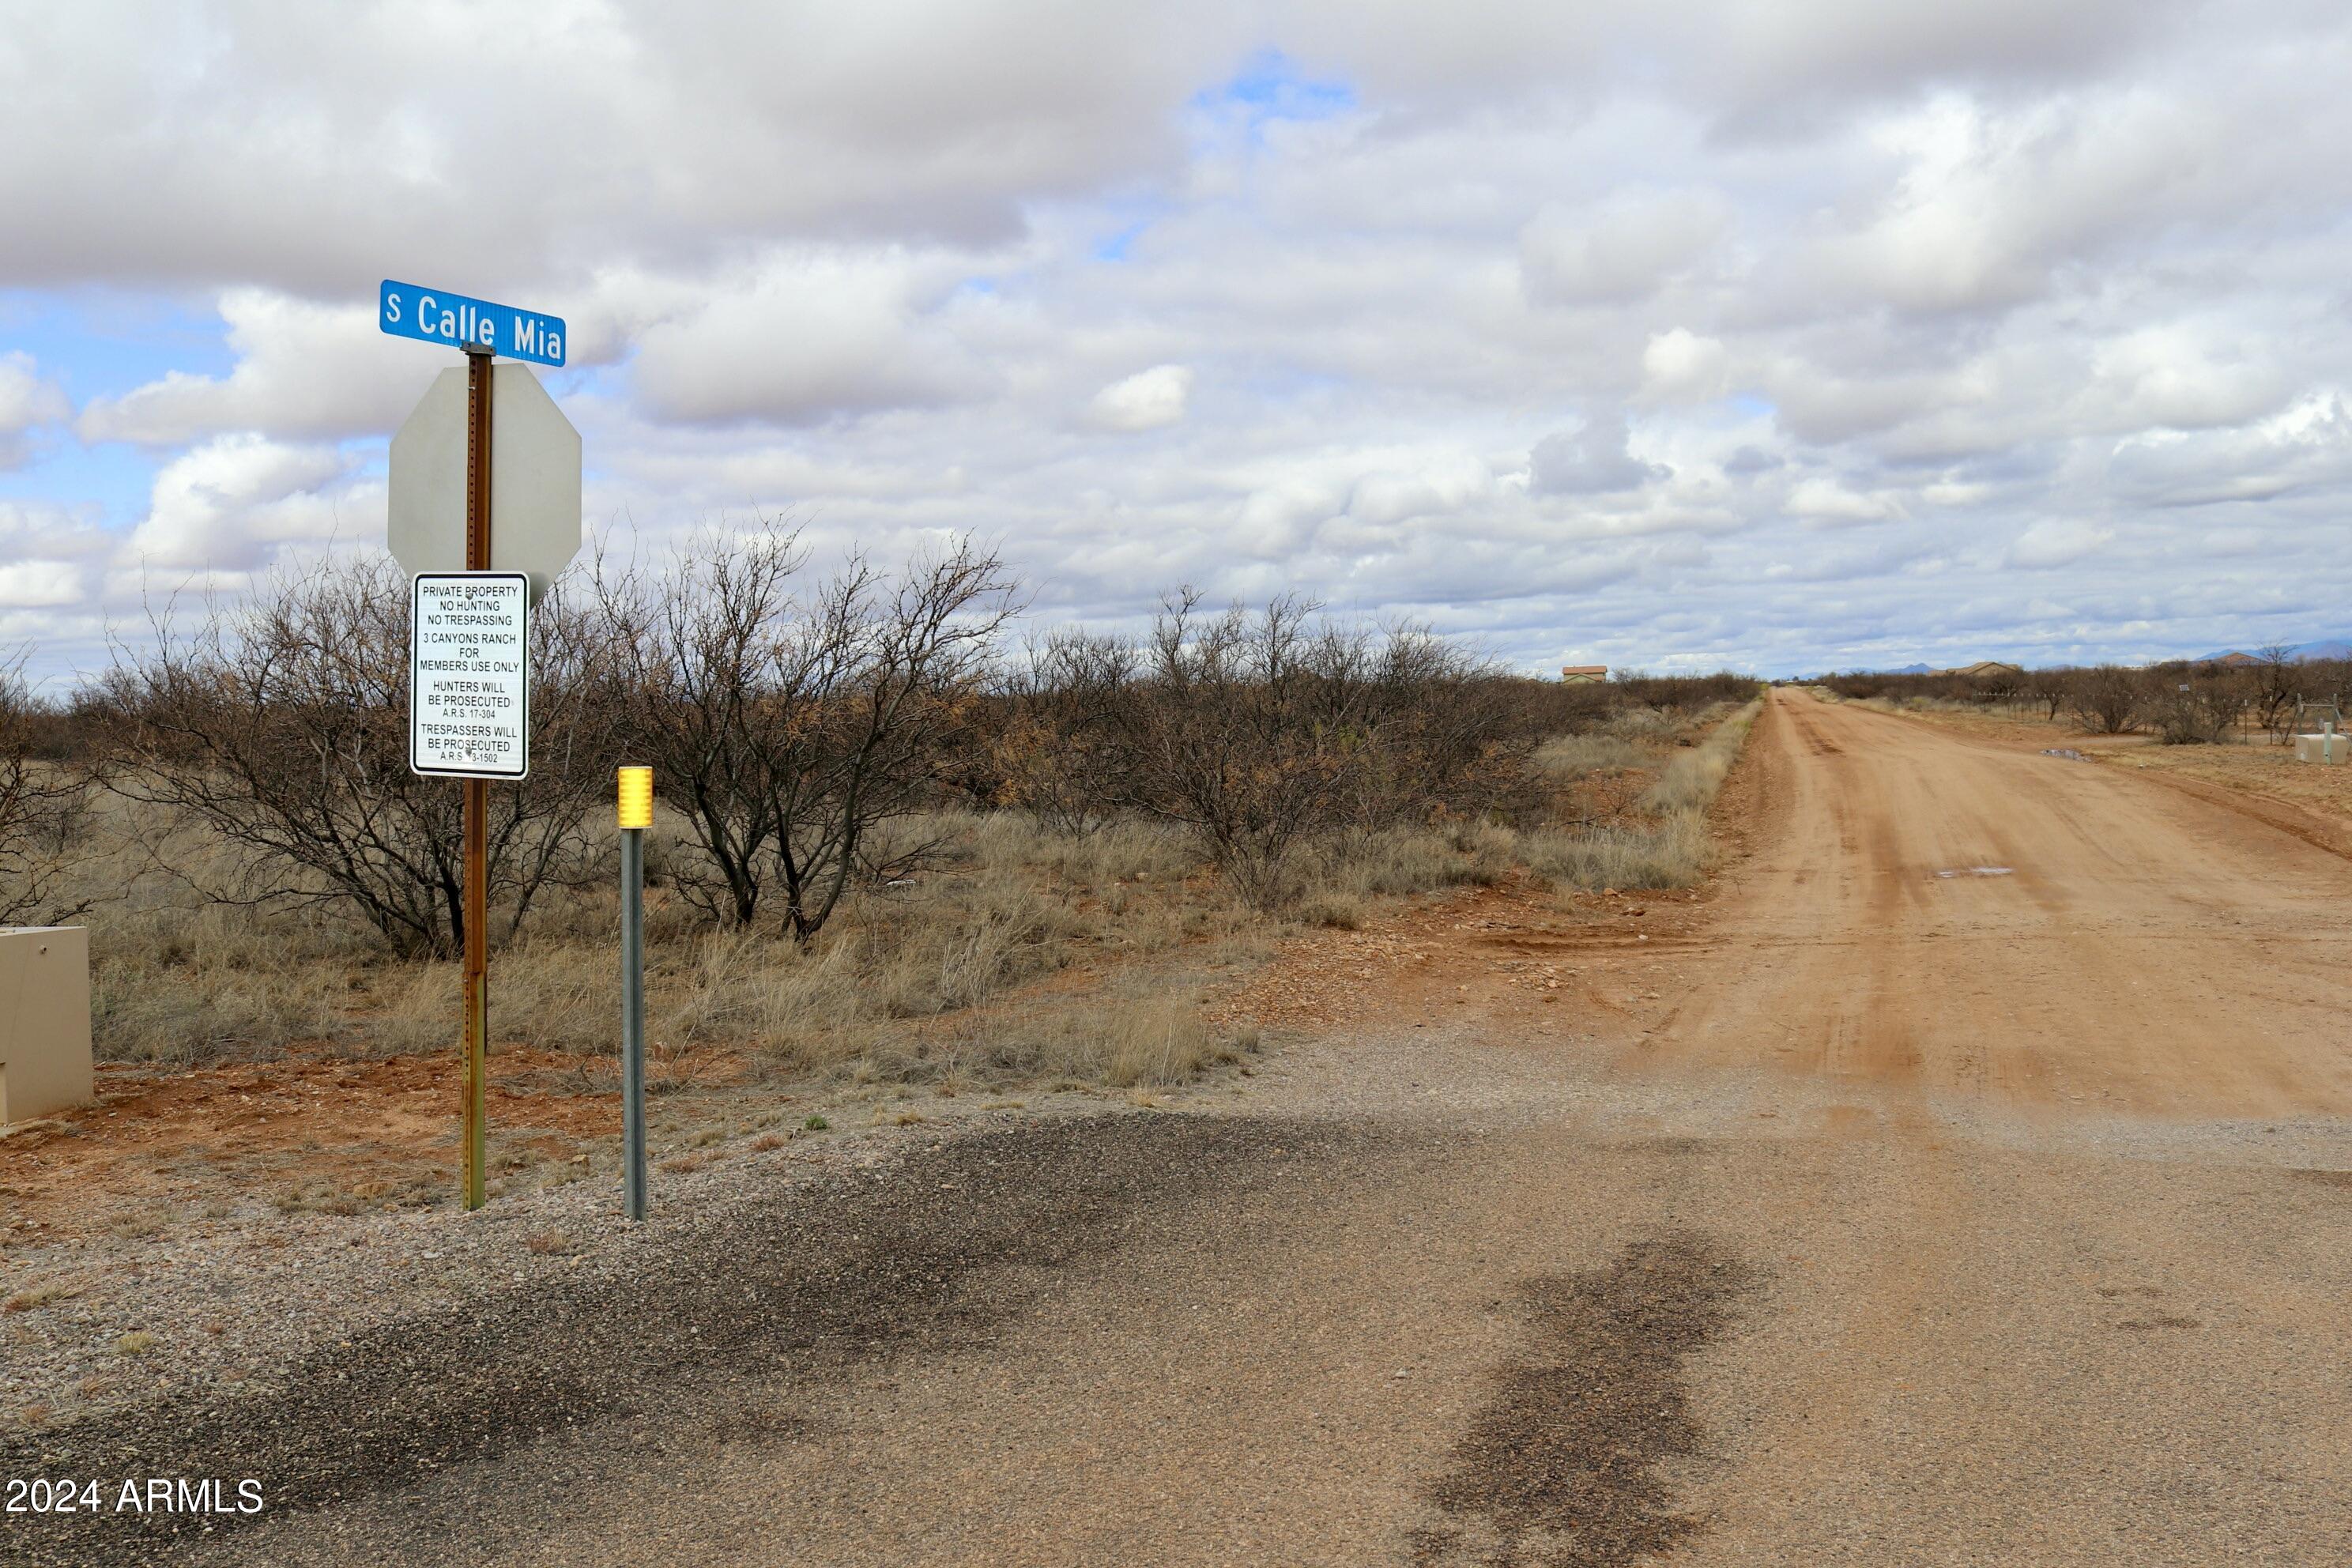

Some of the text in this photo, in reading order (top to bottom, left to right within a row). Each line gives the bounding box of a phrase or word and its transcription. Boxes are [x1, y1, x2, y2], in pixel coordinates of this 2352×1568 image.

[386, 292, 561, 360] S Calle Mia
[423, 586, 518, 597] PRIVATE PROPERTY
[440, 600, 499, 611] NO HUNTING
[428, 614, 512, 626] NO TRESPASSING
[424, 632, 516, 644] 3 CANYONS RANCH
[459, 647, 479, 658] FOR
[420, 660, 518, 673] MEMBERS USE ONLY
[433, 680, 505, 693] HUNTERS WILL
[428, 695, 510, 707] BE PROSECUTED
[443, 708, 496, 718] A.R.S. 17-304
[421, 724, 517, 737] TRESPASSERS WILL
[428, 738, 510, 752] BE PROSECUTED
